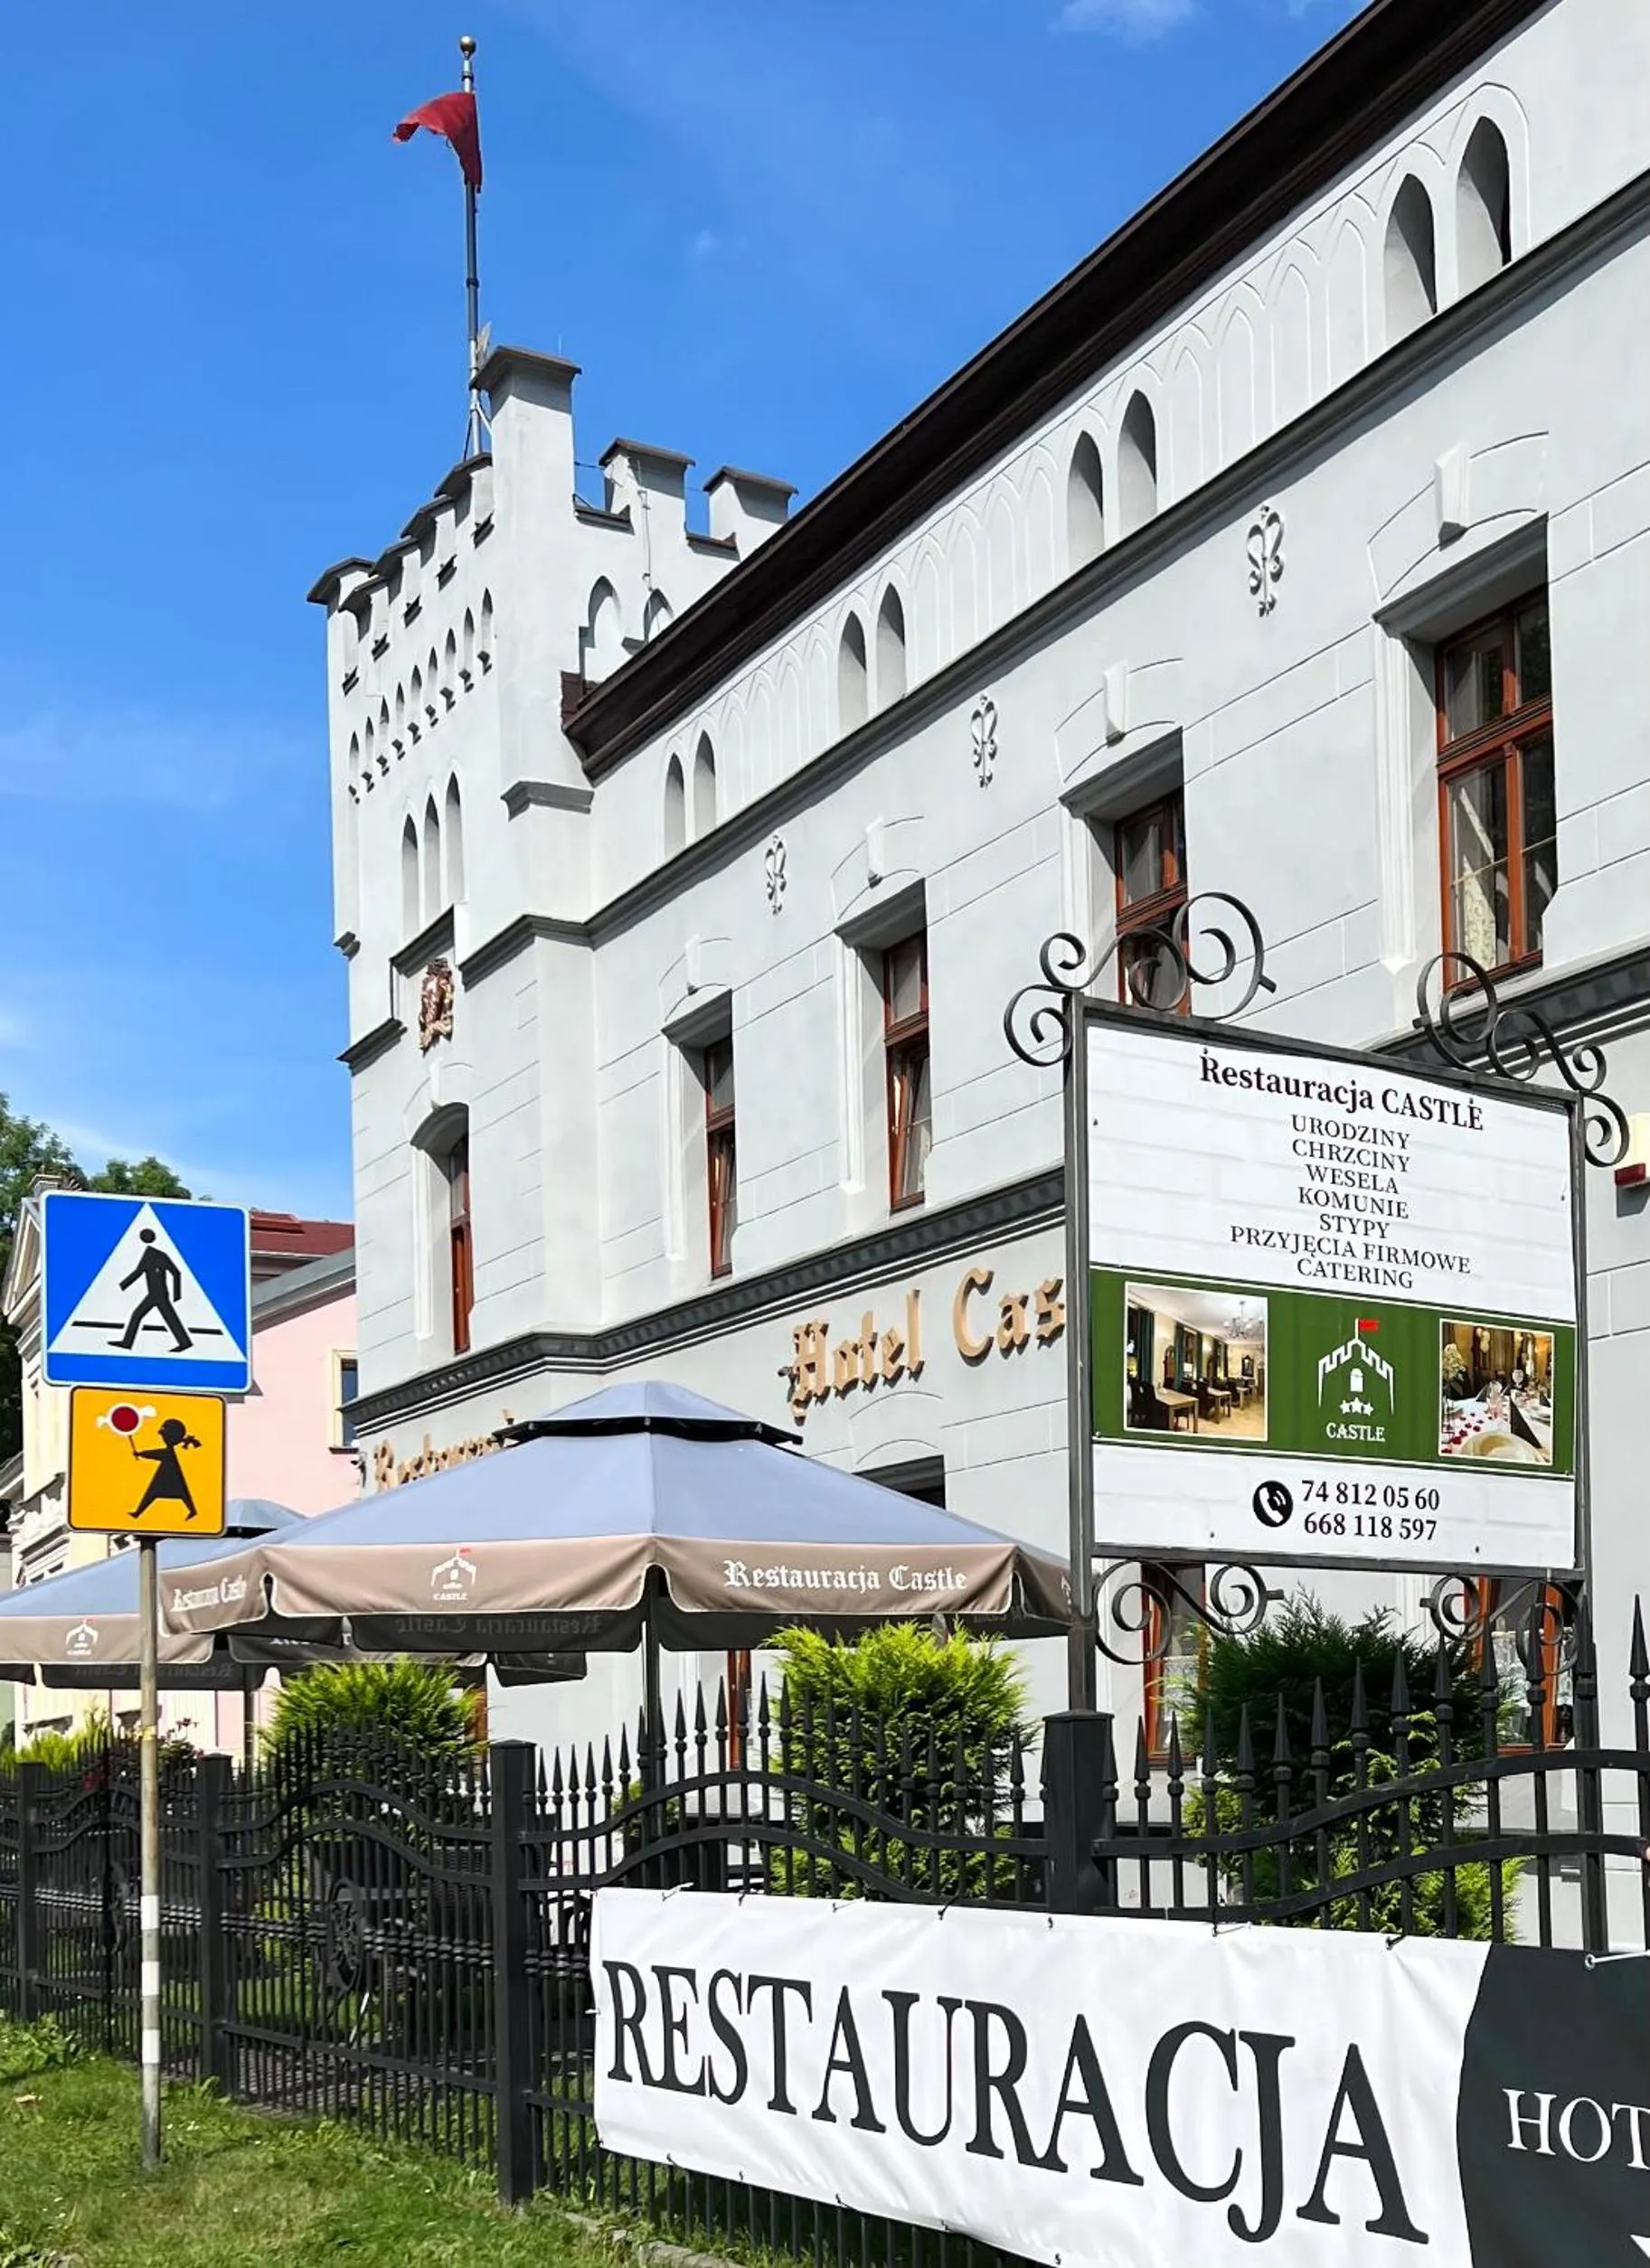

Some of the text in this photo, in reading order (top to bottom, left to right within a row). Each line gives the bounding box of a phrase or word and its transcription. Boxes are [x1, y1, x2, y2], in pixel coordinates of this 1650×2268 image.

[1200, 1056, 1484, 1131] Restauracja CASTLE
[1290, 1114, 1410, 1150] URODZINY
[1292, 1138, 1410, 1172] CHRZCINY
[1305, 1163, 1400, 1194] WESELA
[1298, 1186, 1409, 1219] KOMUNIE
[1319, 1213, 1390, 1239] STYPY
[1230, 1225, 1471, 1274] PRZYJĘCIA FIRMOWE
[1296, 1257, 1413, 1289] CATERING
[791, 1266, 1066, 1418] Hotel Cas
[1325, 1422, 1386, 1443] CASTLE
[1301, 1480, 1440, 1511] 74 812 05 60
[1304, 1511, 1438, 1540] 668 118 597
[723, 1560, 968, 1594] Restauracja Castle
[602, 1960, 1428, 2244] RESTAURACJA
[1502, 2088, 1650, 2170] HOT
